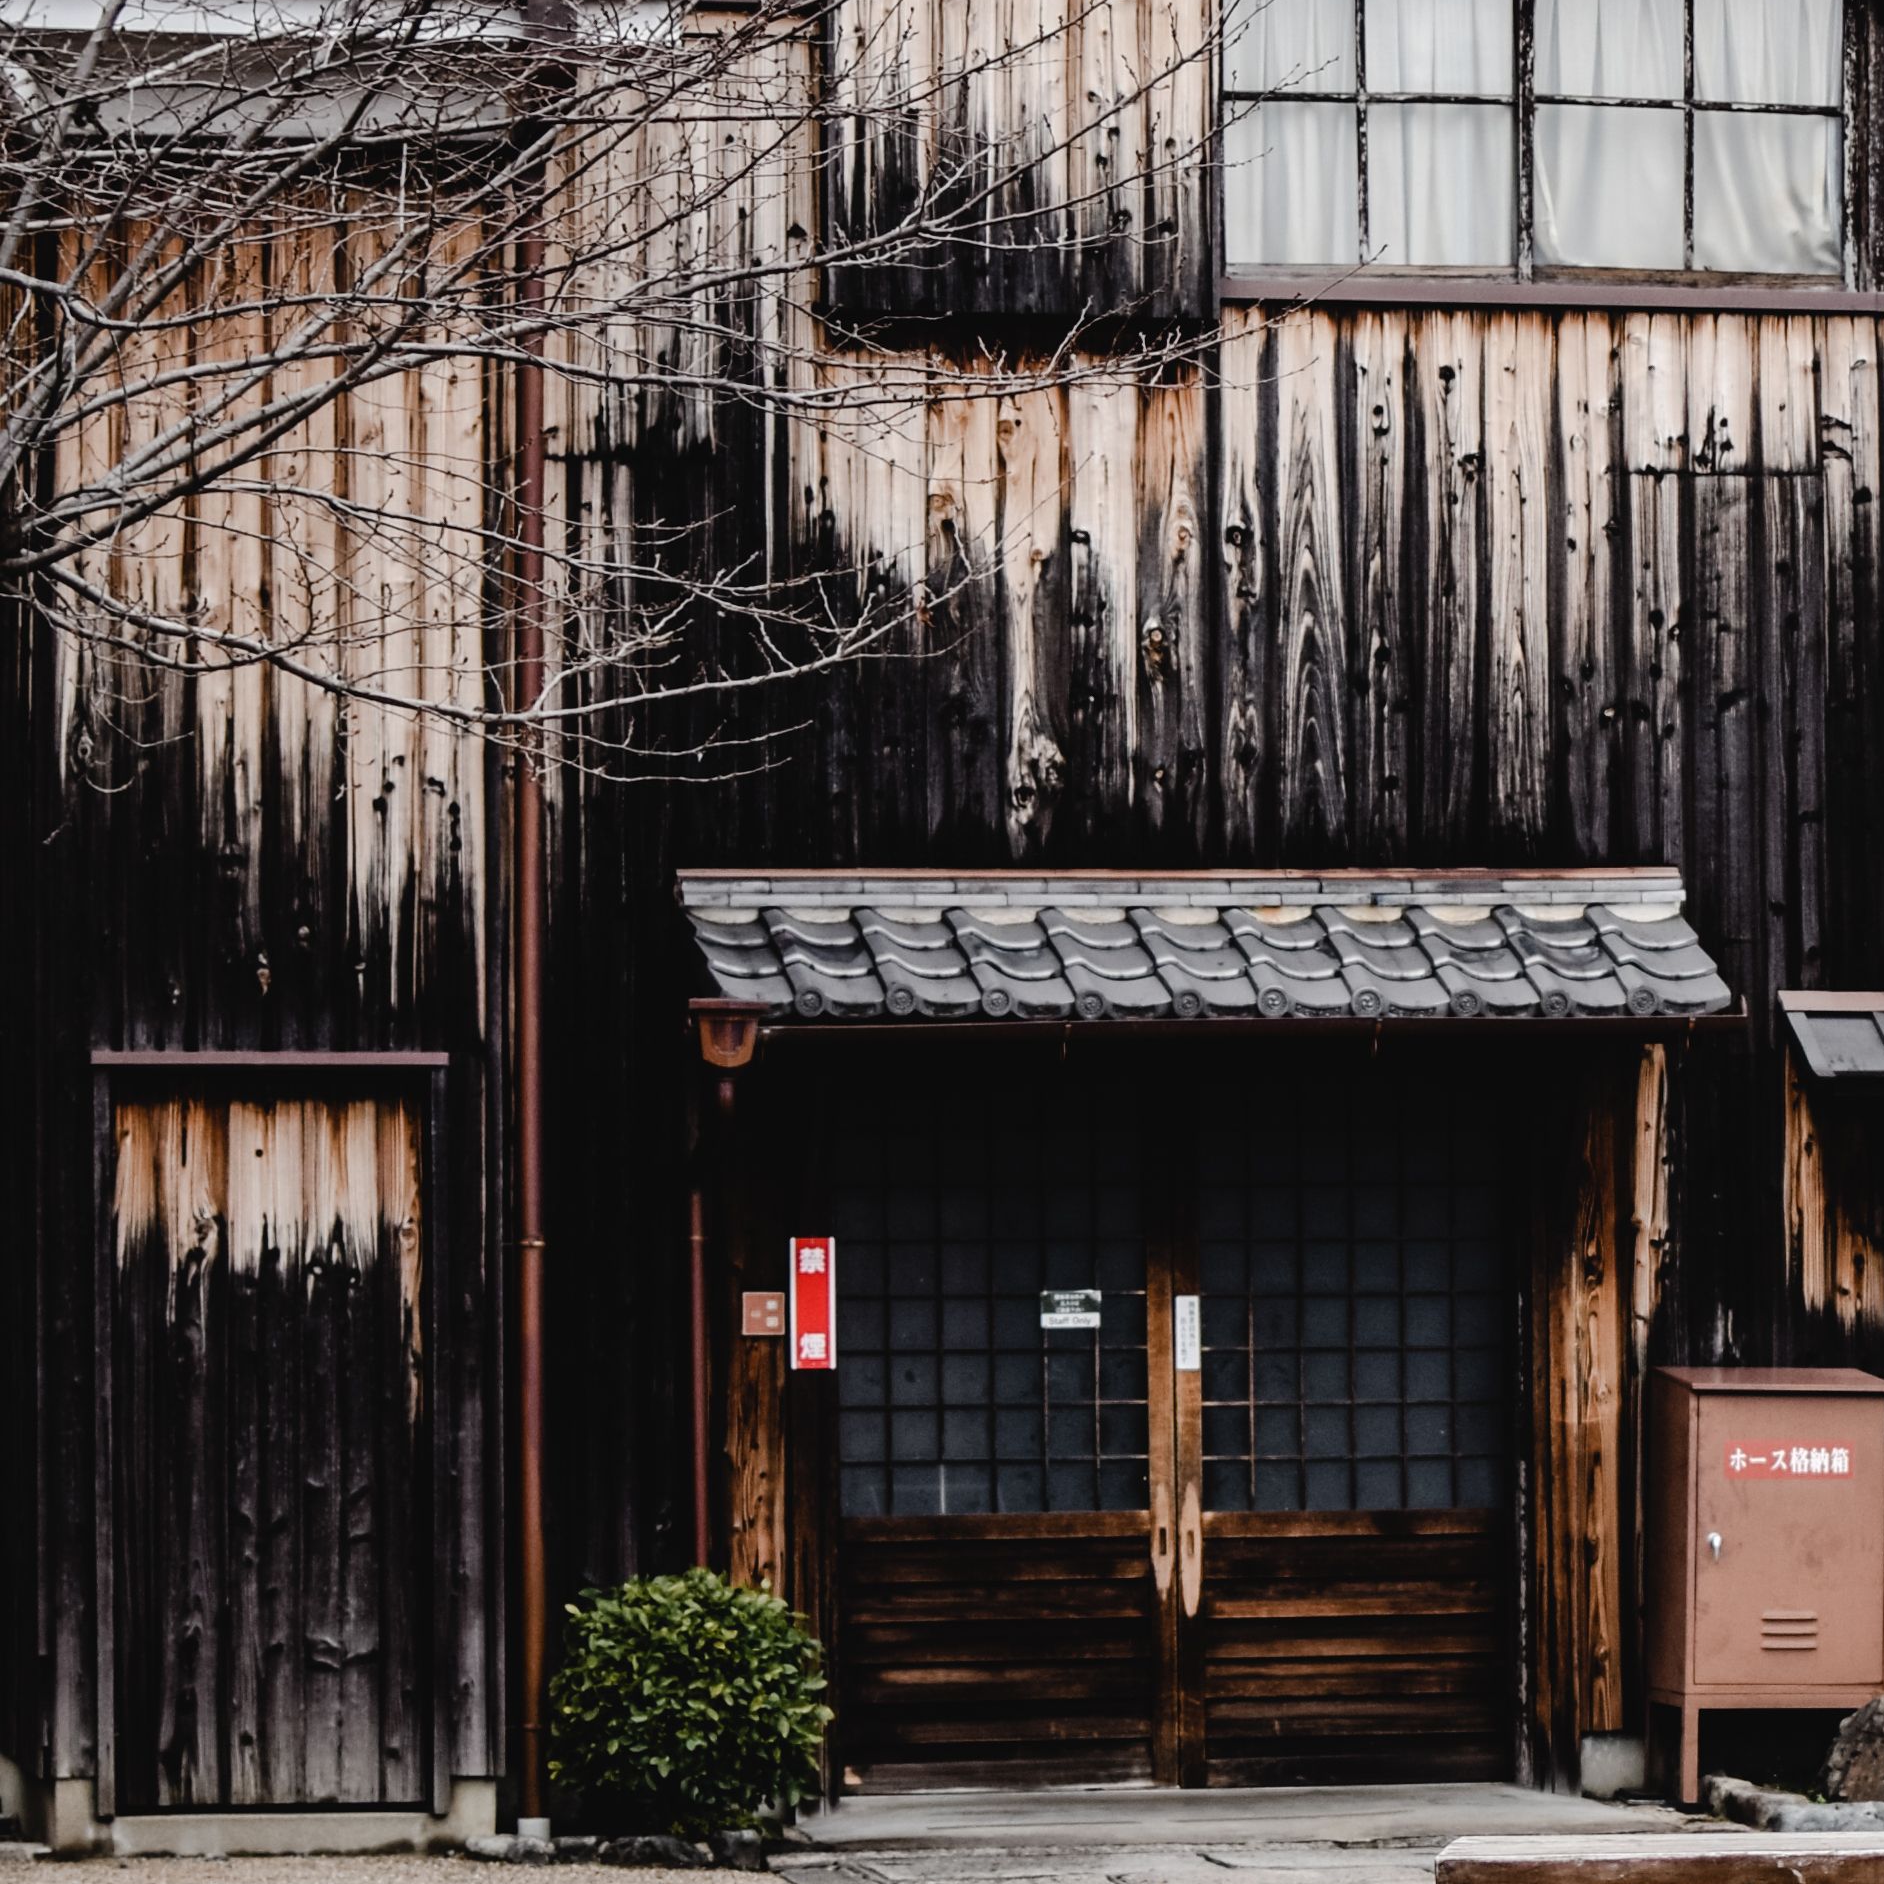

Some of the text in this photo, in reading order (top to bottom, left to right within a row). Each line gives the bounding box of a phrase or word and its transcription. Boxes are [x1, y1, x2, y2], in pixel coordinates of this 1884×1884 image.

[800, 1247, 825, 1359] 禁煙
[1048, 1317, 1091, 1325] Staff Only
[1730, 1447, 1849, 1473] ホース格納箱
